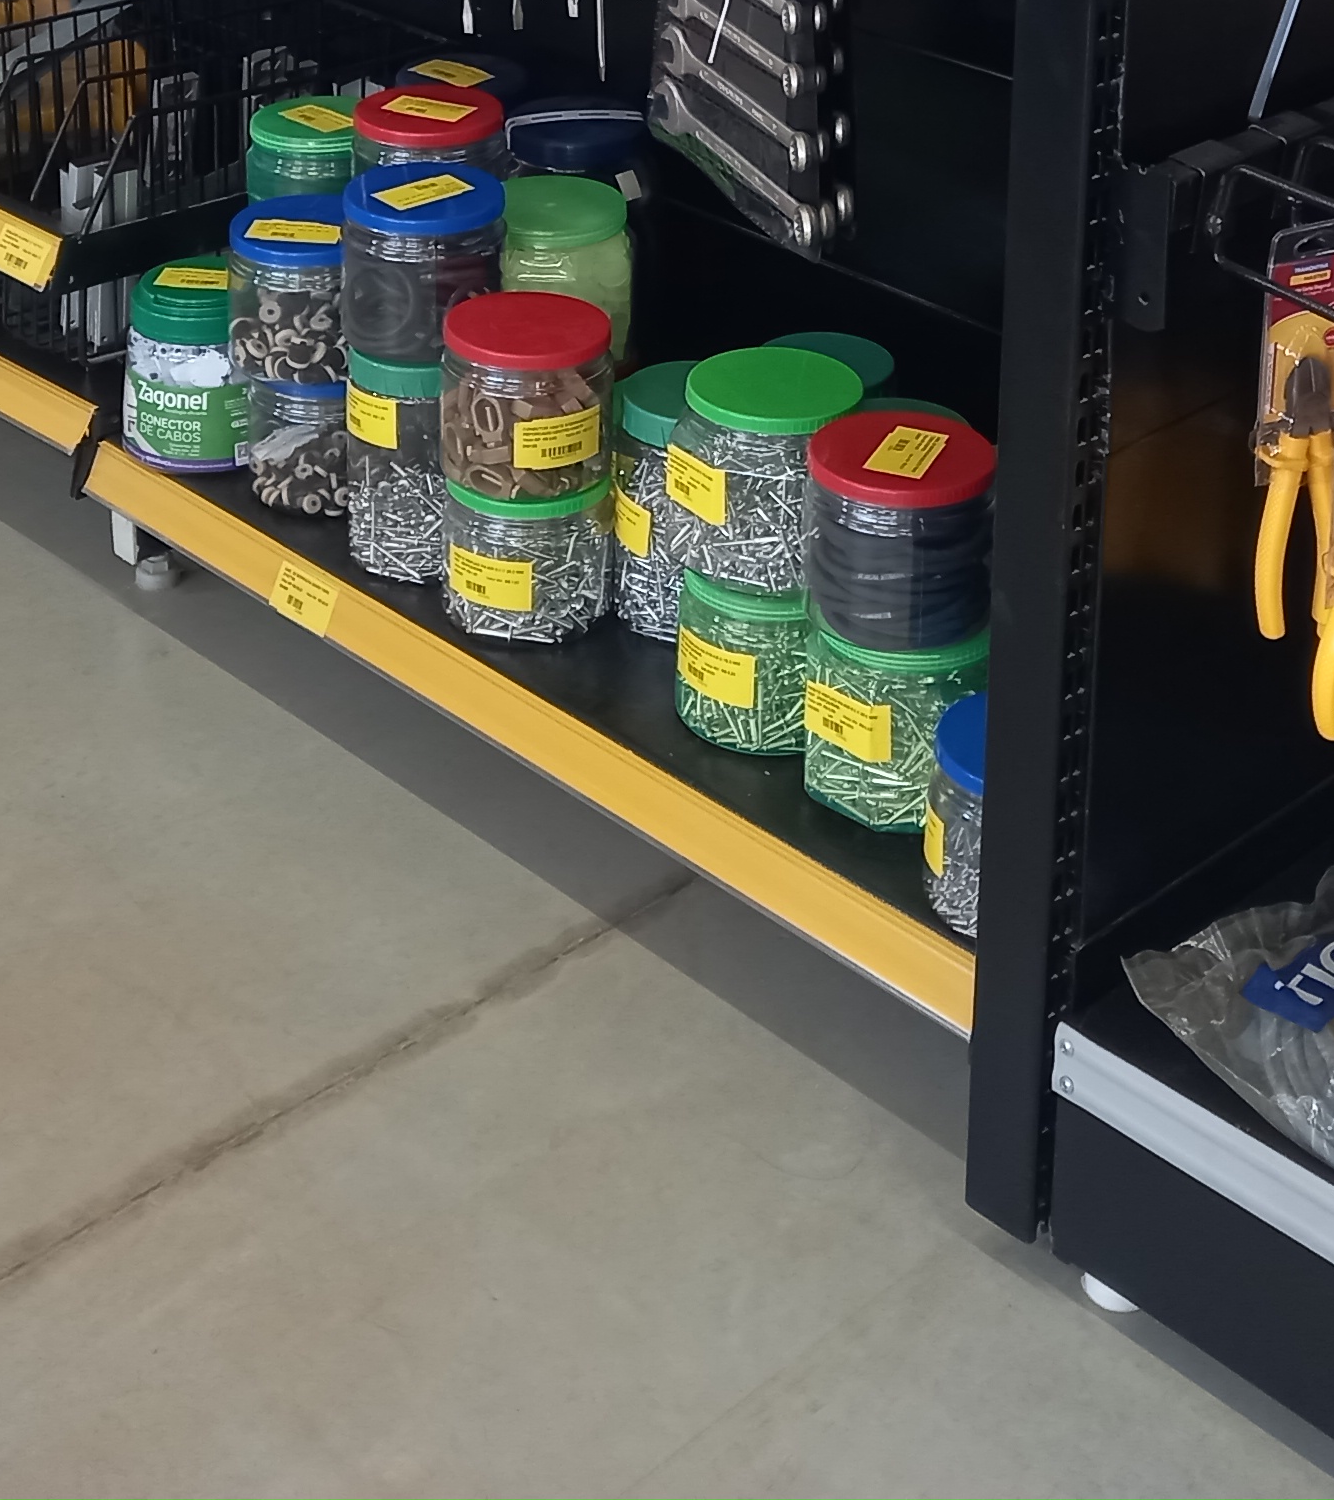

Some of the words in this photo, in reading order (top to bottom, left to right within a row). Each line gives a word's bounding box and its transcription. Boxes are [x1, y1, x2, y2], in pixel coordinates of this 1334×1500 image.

[138, 380, 210, 411] Zagonel
[139, 422, 154, 436] DE
[156, 428, 202, 443] CABOS
[140, 412, 202, 432] CONECTOR
